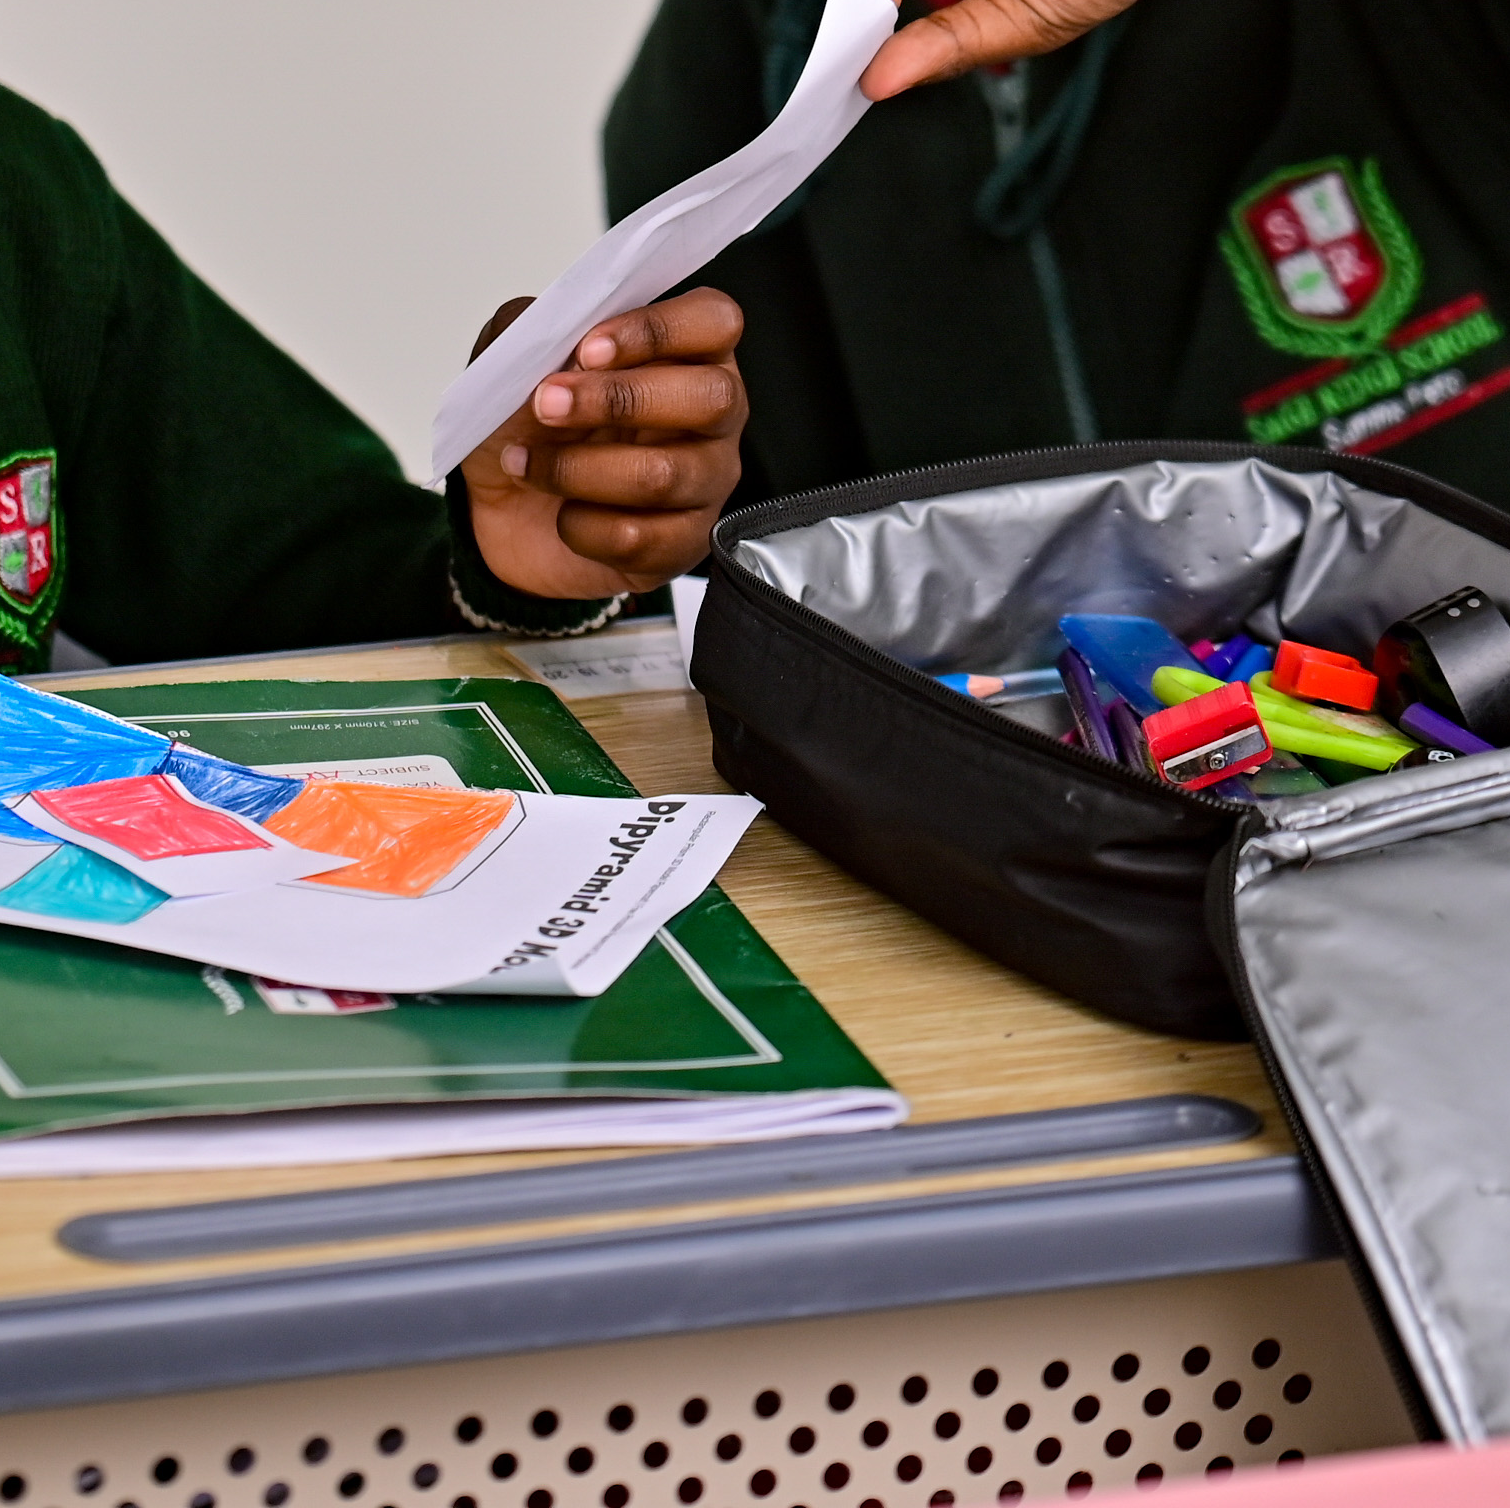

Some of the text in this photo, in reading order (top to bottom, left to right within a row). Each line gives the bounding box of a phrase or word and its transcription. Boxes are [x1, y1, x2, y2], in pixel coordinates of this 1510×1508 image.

[28, 531, 48, 574] R
[357, 763, 431, 777] SUBJECT
[561, 802, 687, 913] Dipyramid
[538, 916, 585, 938] 3D
